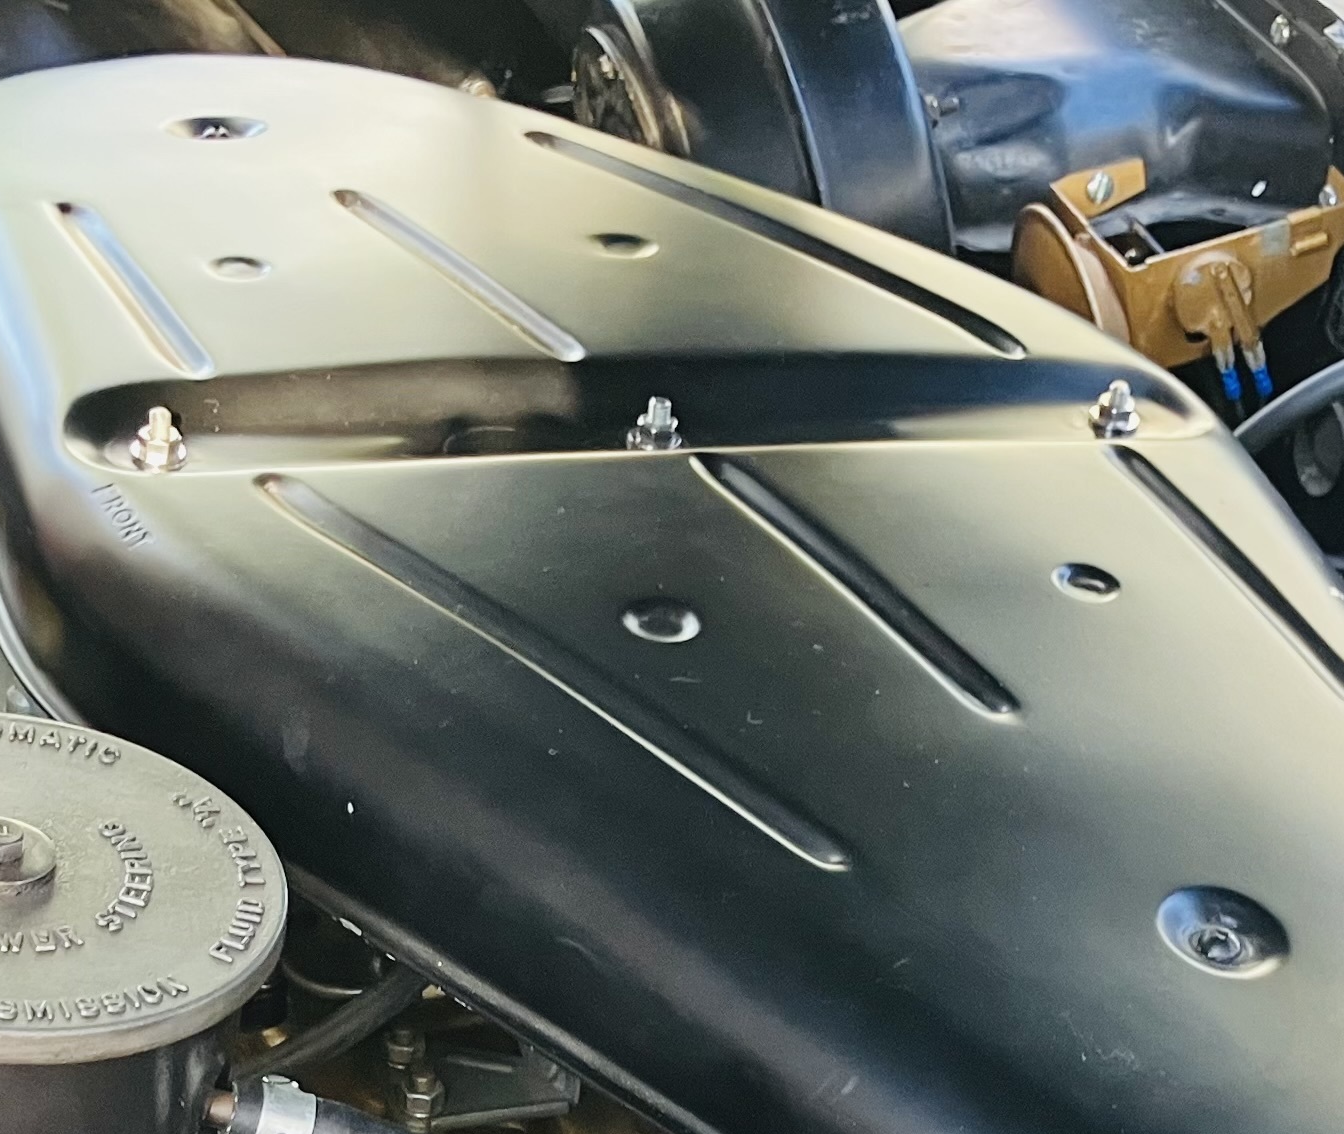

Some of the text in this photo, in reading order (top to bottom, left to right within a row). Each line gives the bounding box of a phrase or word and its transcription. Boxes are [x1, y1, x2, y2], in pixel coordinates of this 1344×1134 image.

[91, 482, 155, 551] FRONT
[94, 819, 155, 933] STEERING
[218, 826, 267, 888] TYPE
[208, 899, 266, 963] FLUID
